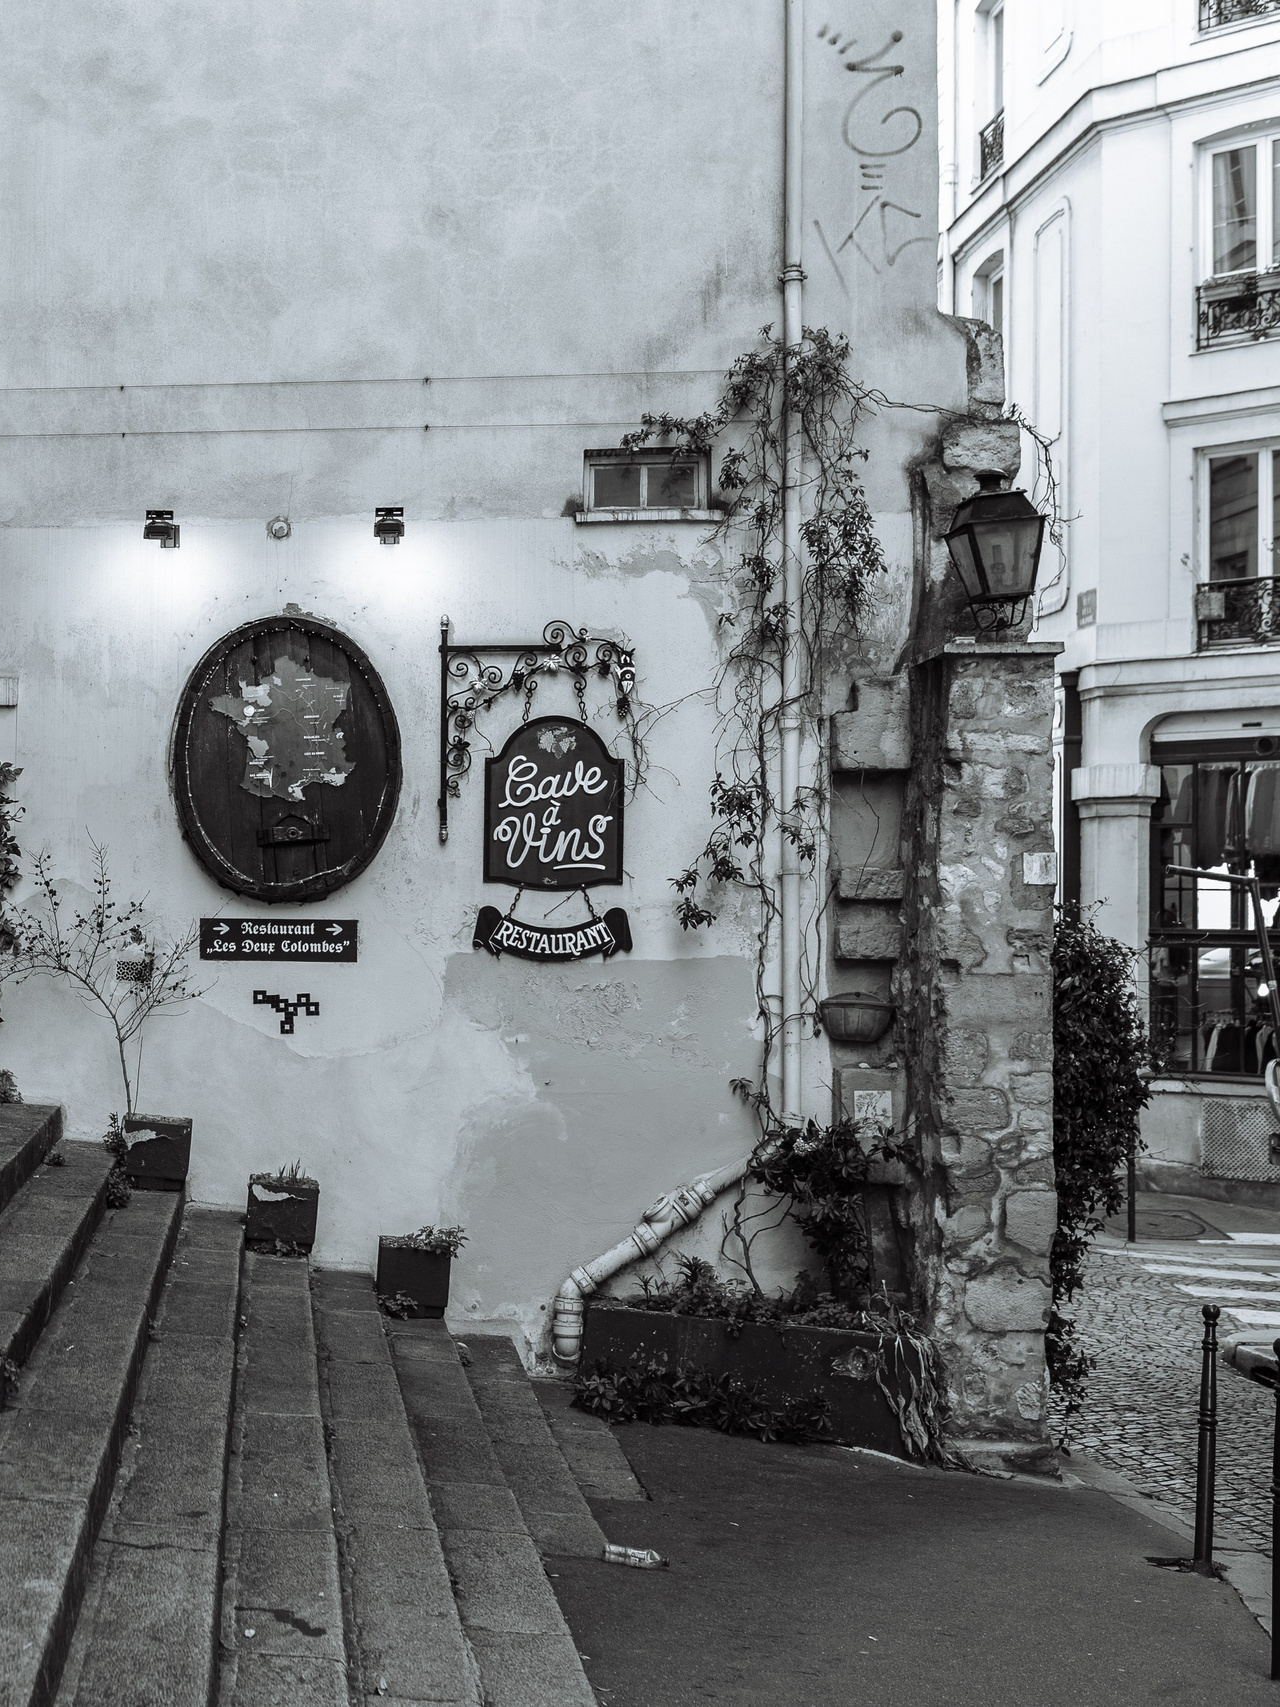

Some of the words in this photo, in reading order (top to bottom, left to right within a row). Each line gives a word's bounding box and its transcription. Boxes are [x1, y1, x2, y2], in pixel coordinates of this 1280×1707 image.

[498, 755, 608, 808] Cave
[542, 800, 561, 826] à
[493, 813, 613, 868] Vins
[241, 922, 315, 935] Restaurant
[495, 920, 610, 955] RESTAURANT
[241, 939, 275, 954] Deux
